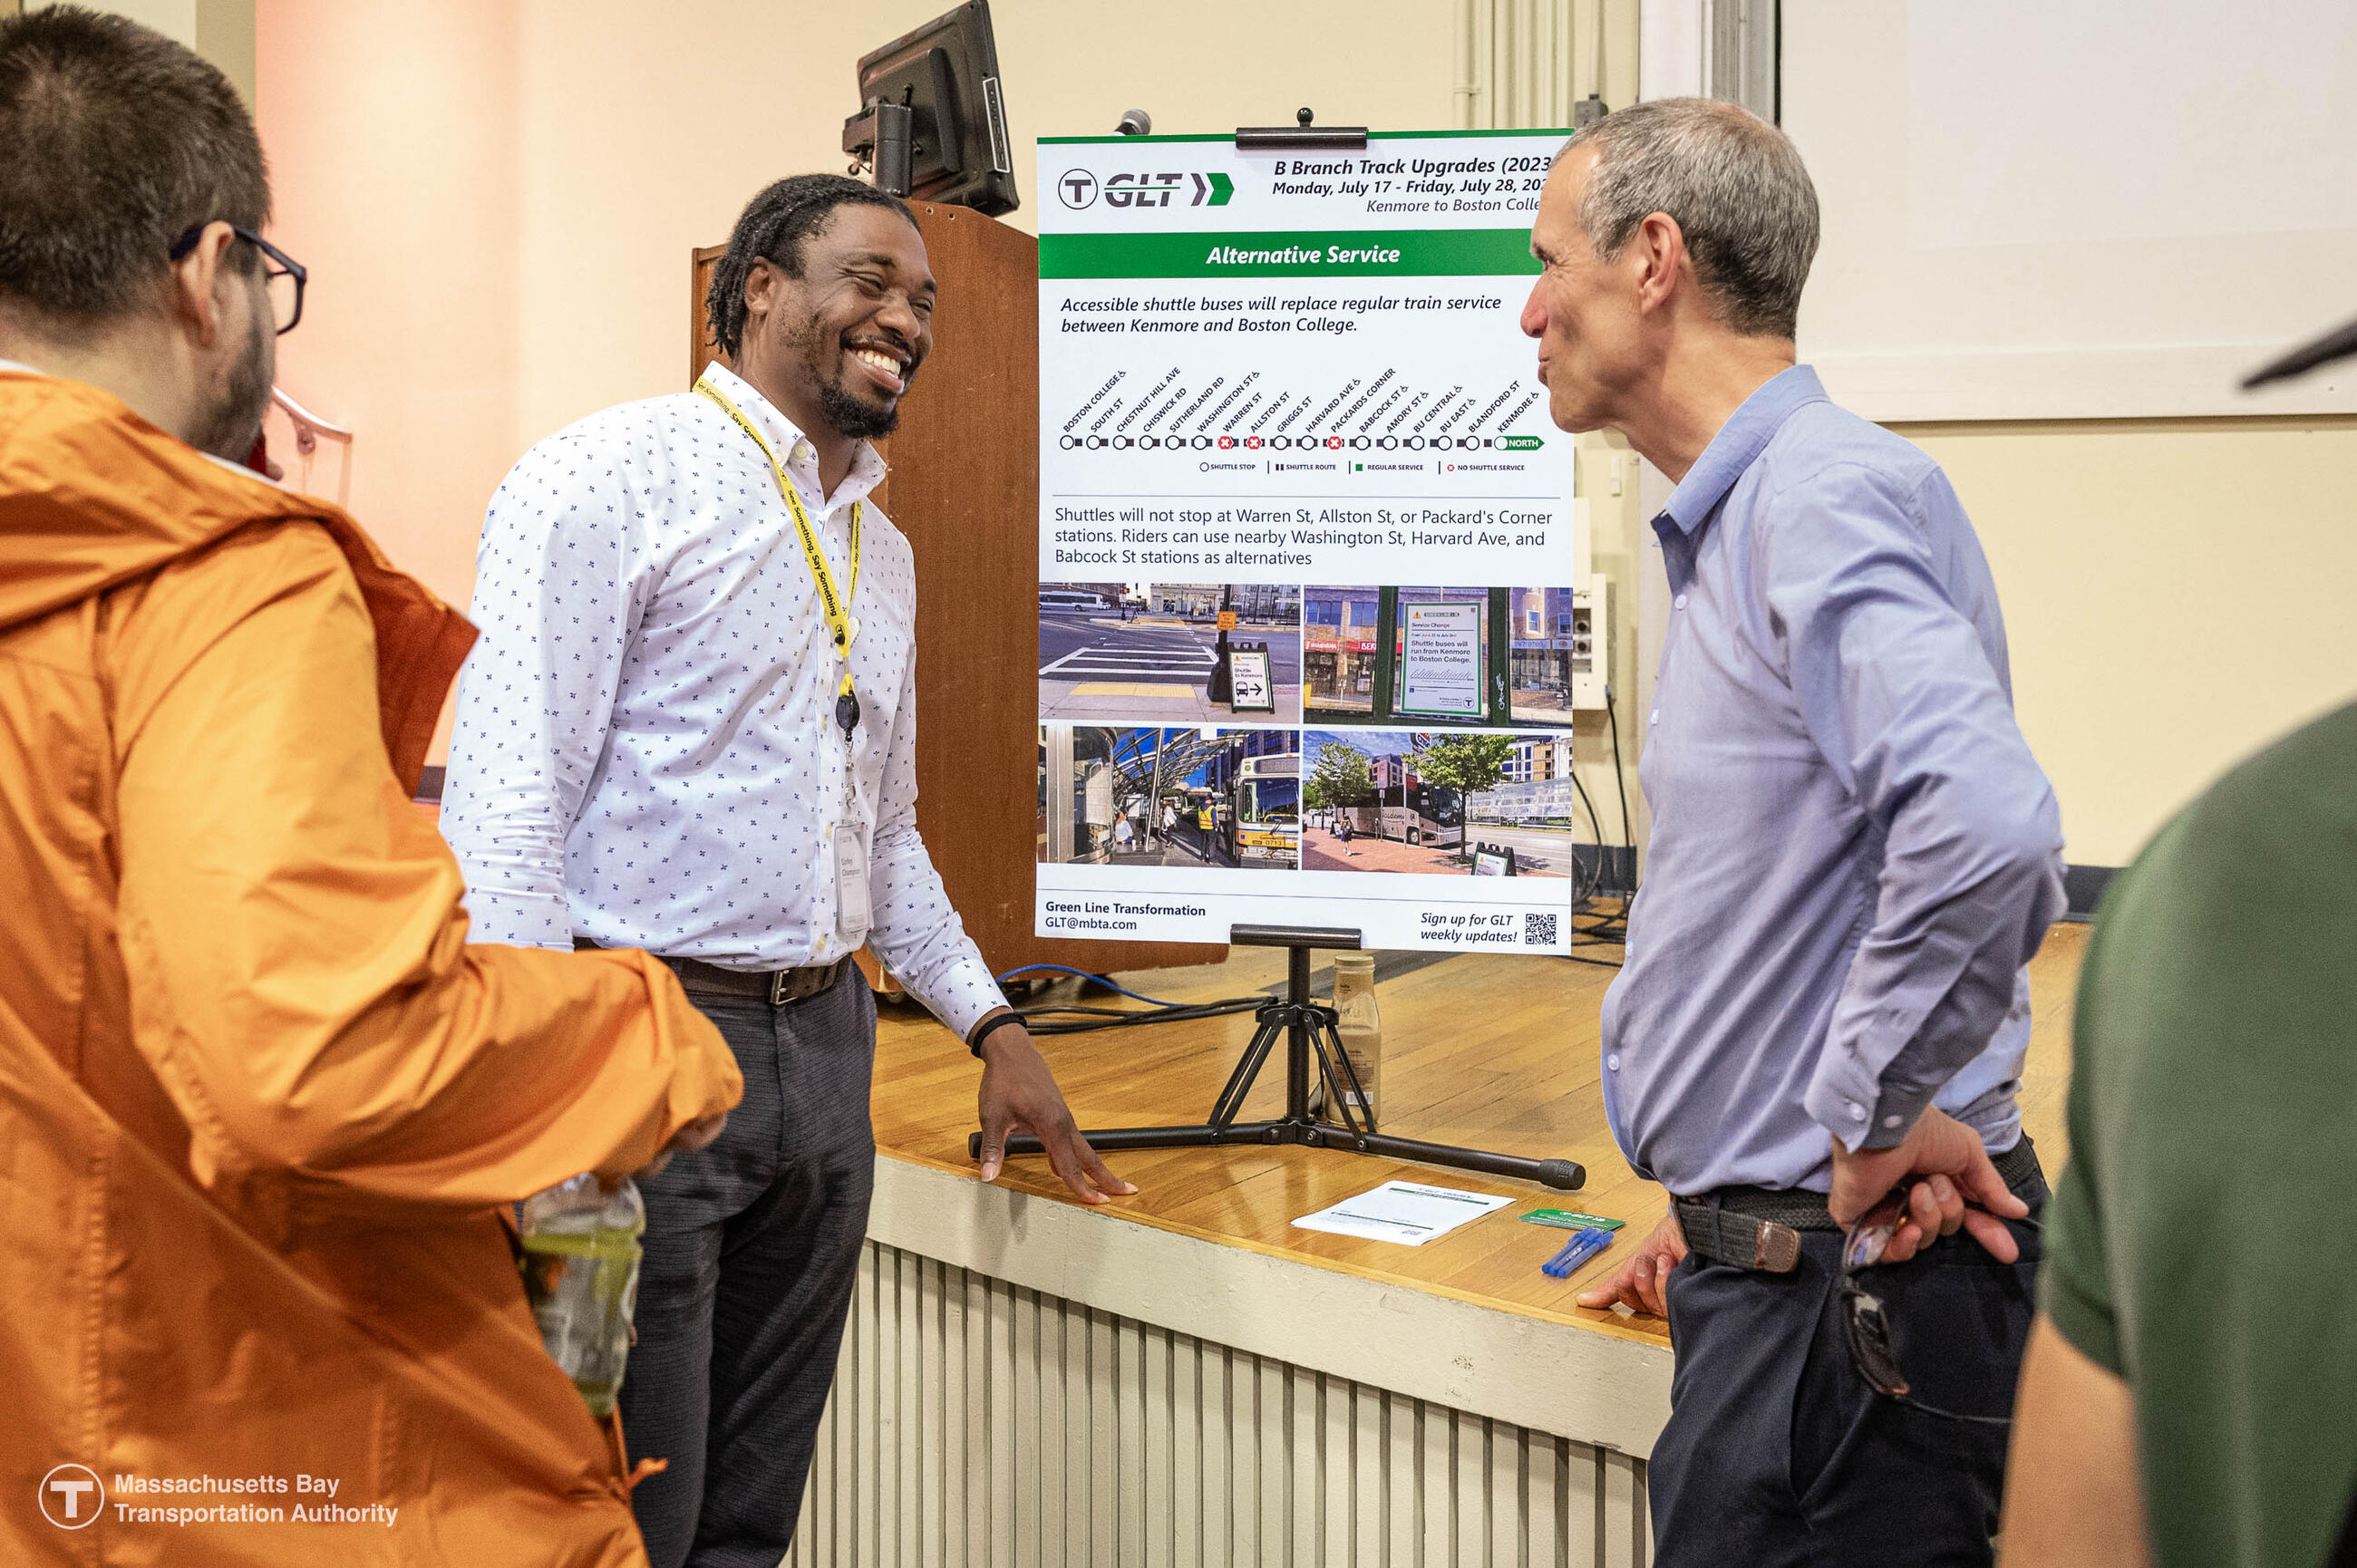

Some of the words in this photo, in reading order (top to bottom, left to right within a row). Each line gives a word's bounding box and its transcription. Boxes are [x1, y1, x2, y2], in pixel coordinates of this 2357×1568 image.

[1274, 159, 1286, 177] B
[1291, 159, 1353, 176] Branch
[1358, 158, 1406, 175] Track
[1411, 157, 1496, 179] Upgrades
[1501, 156, 1552, 175] (2023
[1103, 172, 1183, 208] GLT
[1272, 181, 1334, 198] Monday,
[1337, 180, 1369, 198] July
[1373, 180, 1392, 194] 17
[1405, 179, 1456, 197] Friday,
[1460, 179, 1491, 196] July
[1495, 179, 1518, 193] 28,
[1521, 178, 1547, 191] 20
[1366, 199, 1431, 213] Kenmore
[1434, 199, 1449, 212] to
[1452, 198, 1501, 212] Boston
[1506, 197, 1540, 211] Colle
[1205, 245, 1322, 265] Alternative
[1326, 244, 1401, 264] Service
[1060, 296, 1139, 312] Accessible
[1142, 296, 1197, 312] shuttle
[1200, 296, 1244, 311] buses
[1248, 295, 1276, 311] will
[1280, 295, 1338, 315] replace
[1342, 295, 1401, 315] regular
[1404, 295, 1442, 310] train
[1446, 295, 1501, 310] service
[1061, 318, 1125, 333] between
[1130, 318, 1199, 333] Kenmore
[1203, 317, 1234, 332] and
[1237, 318, 1291, 332] Boston
[1296, 316, 1357, 335] College.
[1063, 403, 1092, 432] BOSTON
[1091, 374, 1120, 405] COLLEGE
[1091, 407, 1116, 432] SOUTH
[1113, 398, 1124, 411] ST
[1117, 396, 1151, 432] CHESTNUT
[1150, 382, 1167, 399] HILL
[1165, 367, 1181, 384] AVE
[1143, 398, 1177, 432] CHISWICK
[1175, 387, 1187, 400] RD
[1169, 387, 1214, 432] SUTHERLAND
[1212, 377, 1225, 390] RD
[1197, 384, 1245, 432] WASHINGTON
[1243, 374, 1254, 388] ST
[1222, 402, 1254, 432] WARREN
[1252, 392, 1263, 404] ST
[1250, 401, 1282, 433] ALLSTON
[1280, 392, 1291, 404] ST
[1276, 405, 1304, 432] GRIGGS
[1302, 396, 1313, 409] ST
[1305, 398, 1340, 433] HARVARD
[1339, 383, 1354, 401] AVE
[1330, 395, 1368, 432] PACKARDS
[1366, 368, 1396, 397] CORNER
[1359, 399, 1393, 433] BABCOCK
[1391, 390, 1402, 402] ST
[1386, 405, 1412, 433] AMORY
[1411, 396, 1421, 408] ST
[1413, 420, 1425, 433] BU
[1424, 391, 1457, 422] CENTRAL
[1468, 391, 1511, 433] BLANDFORD
[1509, 380, 1520, 392] ST
[1497, 397, 1533, 433] KENMORE
[1440, 420, 1452, 433] BU
[1450, 402, 1470, 422] EAST
[1508, 439, 1538, 448] NORTH
[1055, 507, 1115, 522] Shuttles
[1119, 507, 1144, 522] will
[1149, 509, 1175, 522] not
[1178, 509, 1212, 527] stop
[1217, 509, 1232, 523] at
[1236, 508, 1291, 523] Warren
[1296, 508, 1314, 525] St,
[1319, 508, 1372, 524] Allston
[1377, 508, 1395, 526] St,
[1401, 513, 1418, 524] or
[1422, 508, 1494, 525] Packard's
[1499, 509, 1553, 525] Corner
[788, 489, 797, 506] See
[794, 507, 814, 554] Something,
[812, 555, 822, 570] Say
[818, 571, 837, 616] Something
[1055, 528, 1117, 543] stations.
[1122, 528, 1169, 543] Riders
[1172, 532, 1198, 543] can
[1204, 532, 1230, 544] use
[1235, 529, 1287, 547] nearby
[1291, 529, 1382, 548] Washington
[1388, 530, 1406, 547] St,
[1411, 530, 1472, 546] Harvard
[1478, 531, 1510, 547] Ave,
[1515, 531, 1545, 546] and
[1055, 548, 1118, 564] Babcock
[1122, 549, 1137, 564] St
[1140, 549, 1199, 565] stations
[1204, 553, 1220, 565] as
[1225, 549, 1313, 566] alternatives
[1443, 656, 1471, 664] College.
[1045, 901, 1082, 913] Green
[1085, 902, 1110, 914] Line
[1112, 903, 1206, 916] Transformation
[1045, 916, 1137, 930] GLT@mbta.com
[1421, 912, 1448, 930] Sign
[1450, 915, 1466, 931] up
[1469, 913, 1488, 927] for
[1489, 915, 1514, 926] GLT
[1421, 928, 1463, 944] weekly
[1465, 930, 1518, 944] updates!
